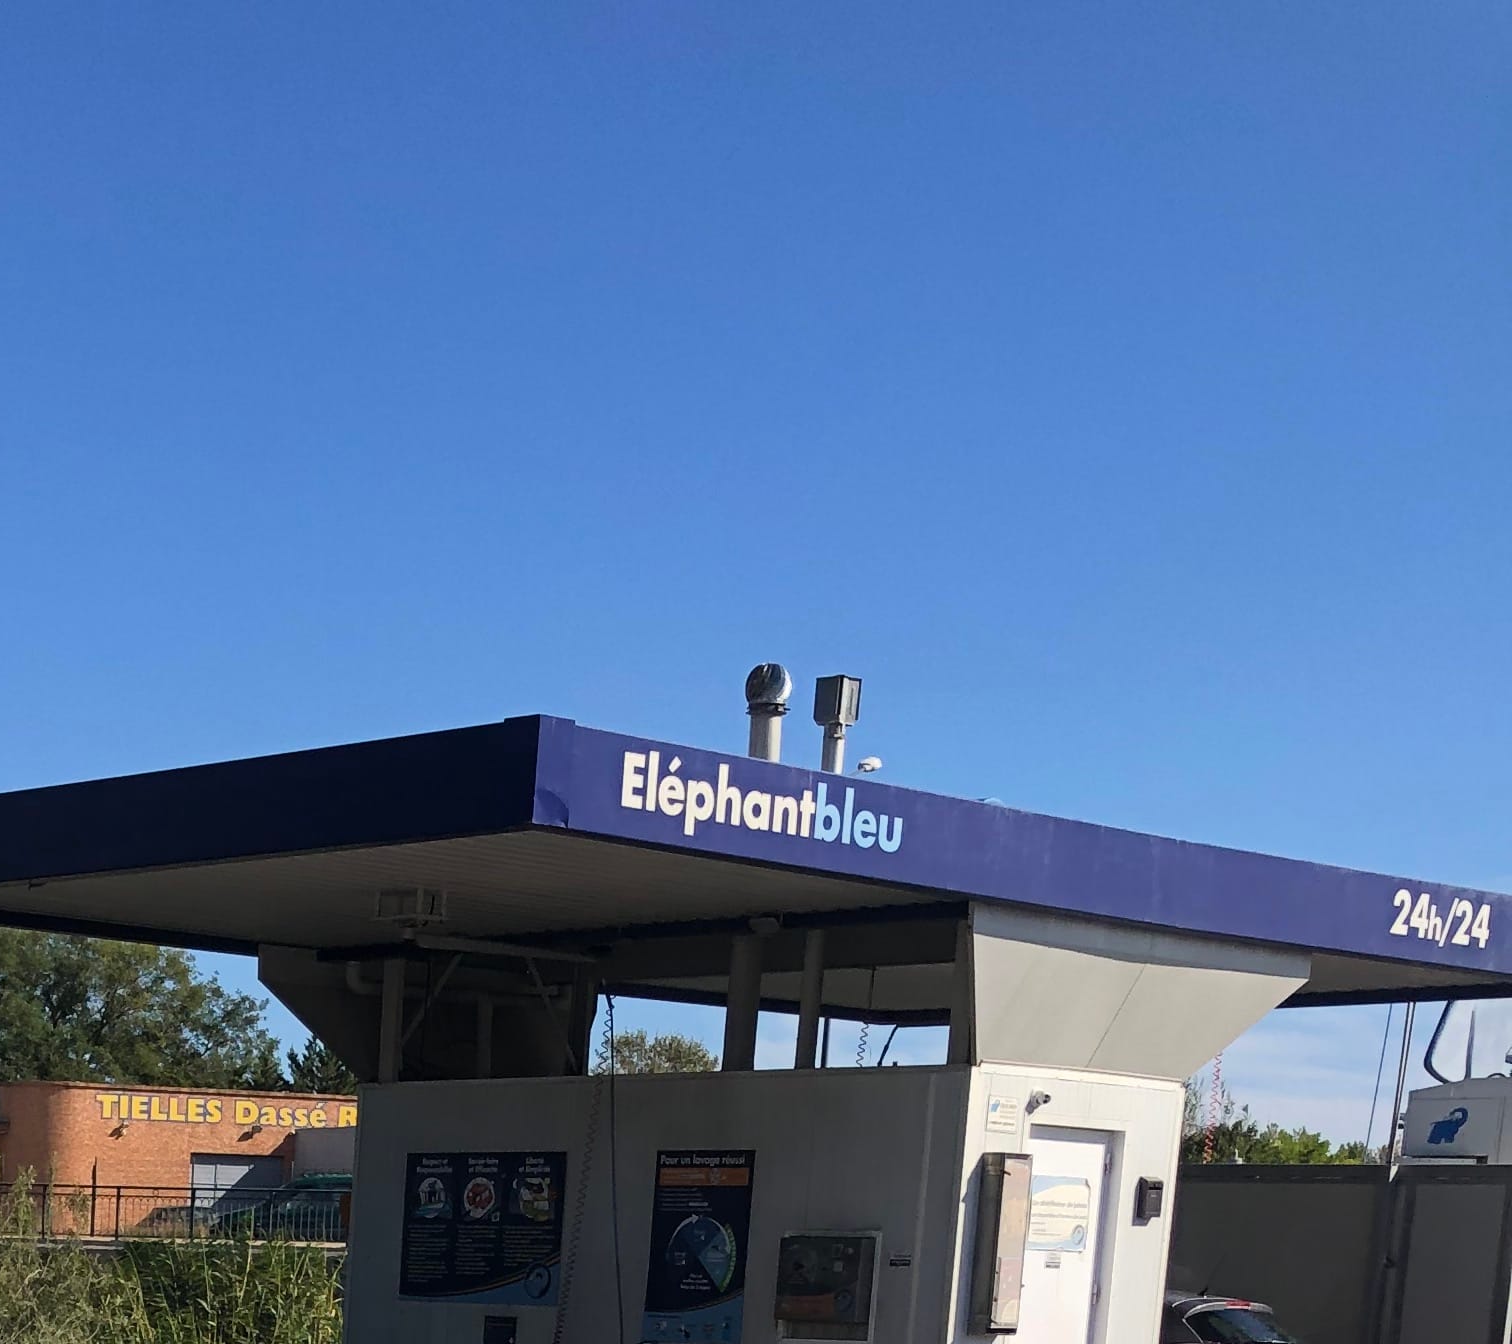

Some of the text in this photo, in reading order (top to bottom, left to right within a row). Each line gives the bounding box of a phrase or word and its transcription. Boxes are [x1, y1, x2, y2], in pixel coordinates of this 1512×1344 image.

[1389, 888, 1491, 949] 24h/24
[95, 1094, 222, 1124] TIELLES
[234, 1100, 328, 1128] Dassé
